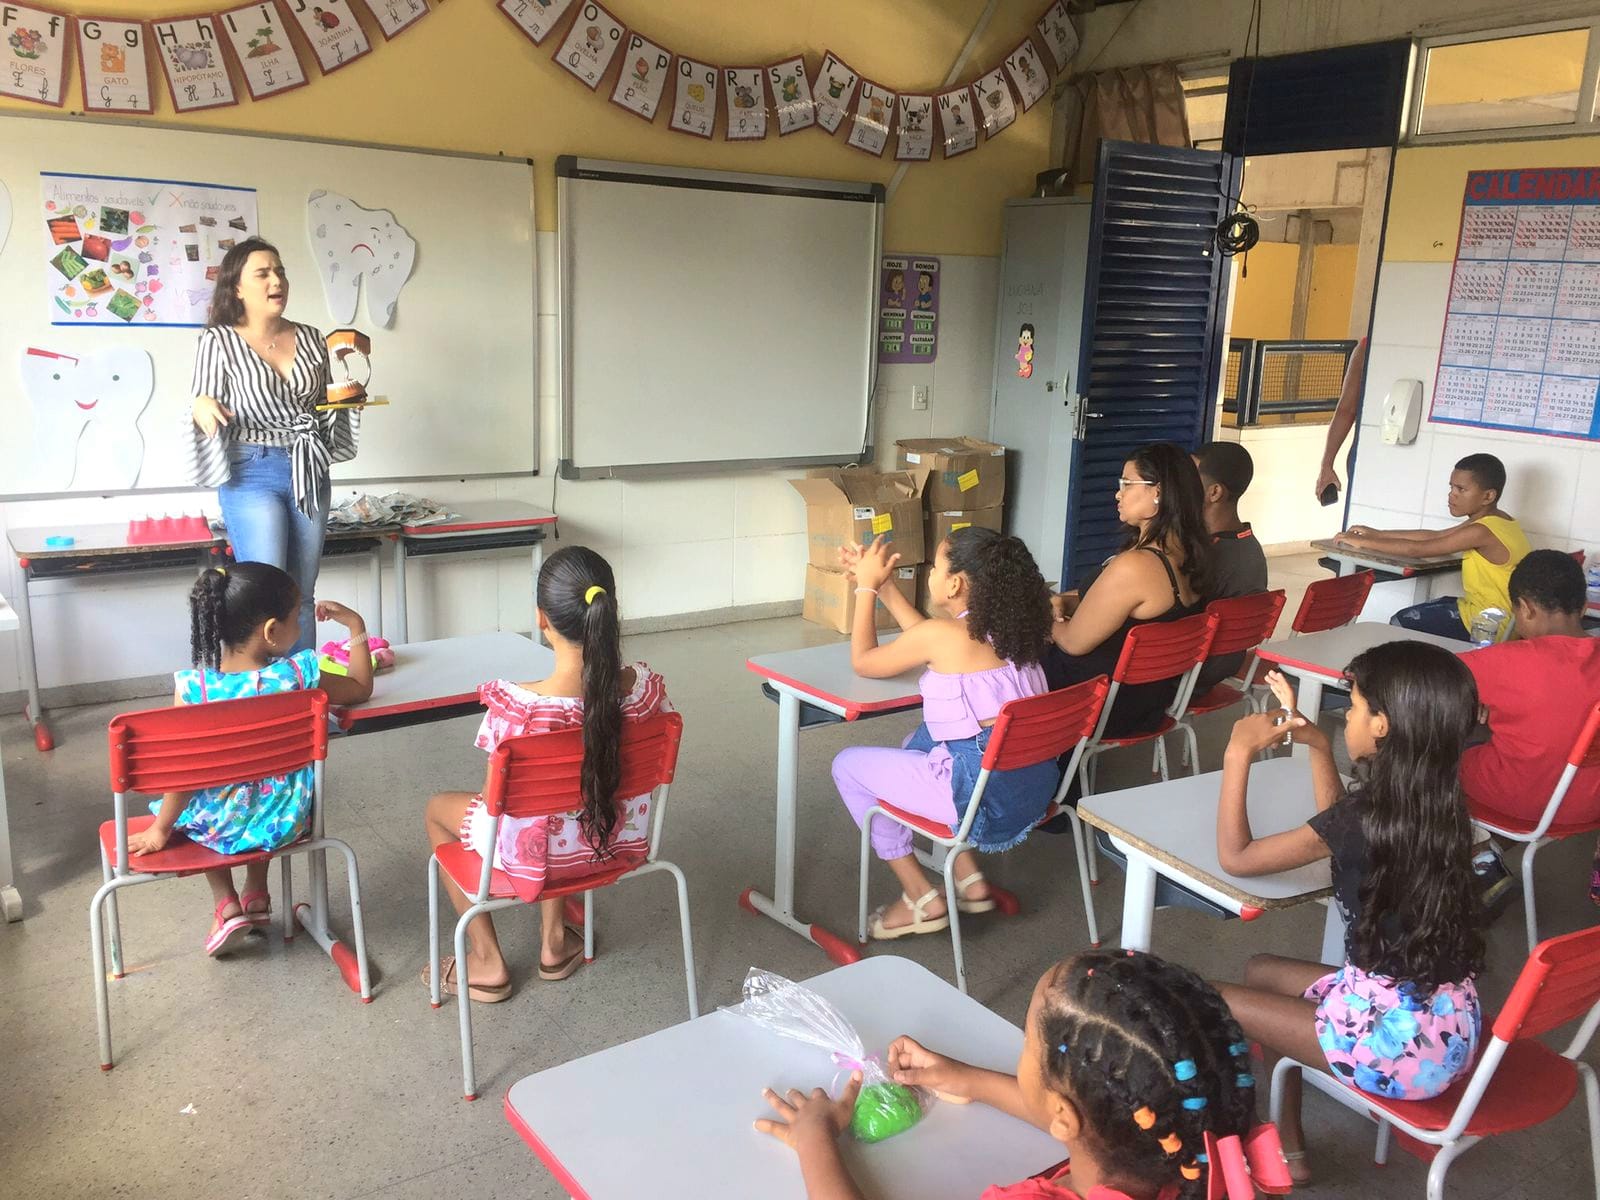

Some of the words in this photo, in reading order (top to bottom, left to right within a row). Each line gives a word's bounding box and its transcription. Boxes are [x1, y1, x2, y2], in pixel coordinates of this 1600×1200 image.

[2, 6, 18, 27] F
[48, 16, 60, 38] f
[260, 4, 271, 24] i
[584, 4, 598, 21] O
[609, 28, 620, 40] o
[83, 21, 102, 40] G
[124, 28, 139, 48] g
[157, 24, 178, 46] H
[196, 19, 214, 41] h
[317, 25, 354, 48] JOANINHA
[630, 36, 643, 51] P
[656, 54, 668, 70] p
[9, 61, 46, 77] FLORES
[827, 56, 838, 73] T
[104, 77, 129, 85] GATO
[680, 61, 692, 79] Q
[705, 72, 715, 89] q
[728, 70, 738, 86] R
[753, 73, 760, 86] r
[771, 68, 782, 84] S
[862, 83, 873, 99] U
[974, 80, 987, 98] X
[901, 97, 910, 112] V
[938, 96, 950, 110] W
[52, 184, 99, 204] Alimentos
[1470, 173, 1600, 200] CALENDAR
